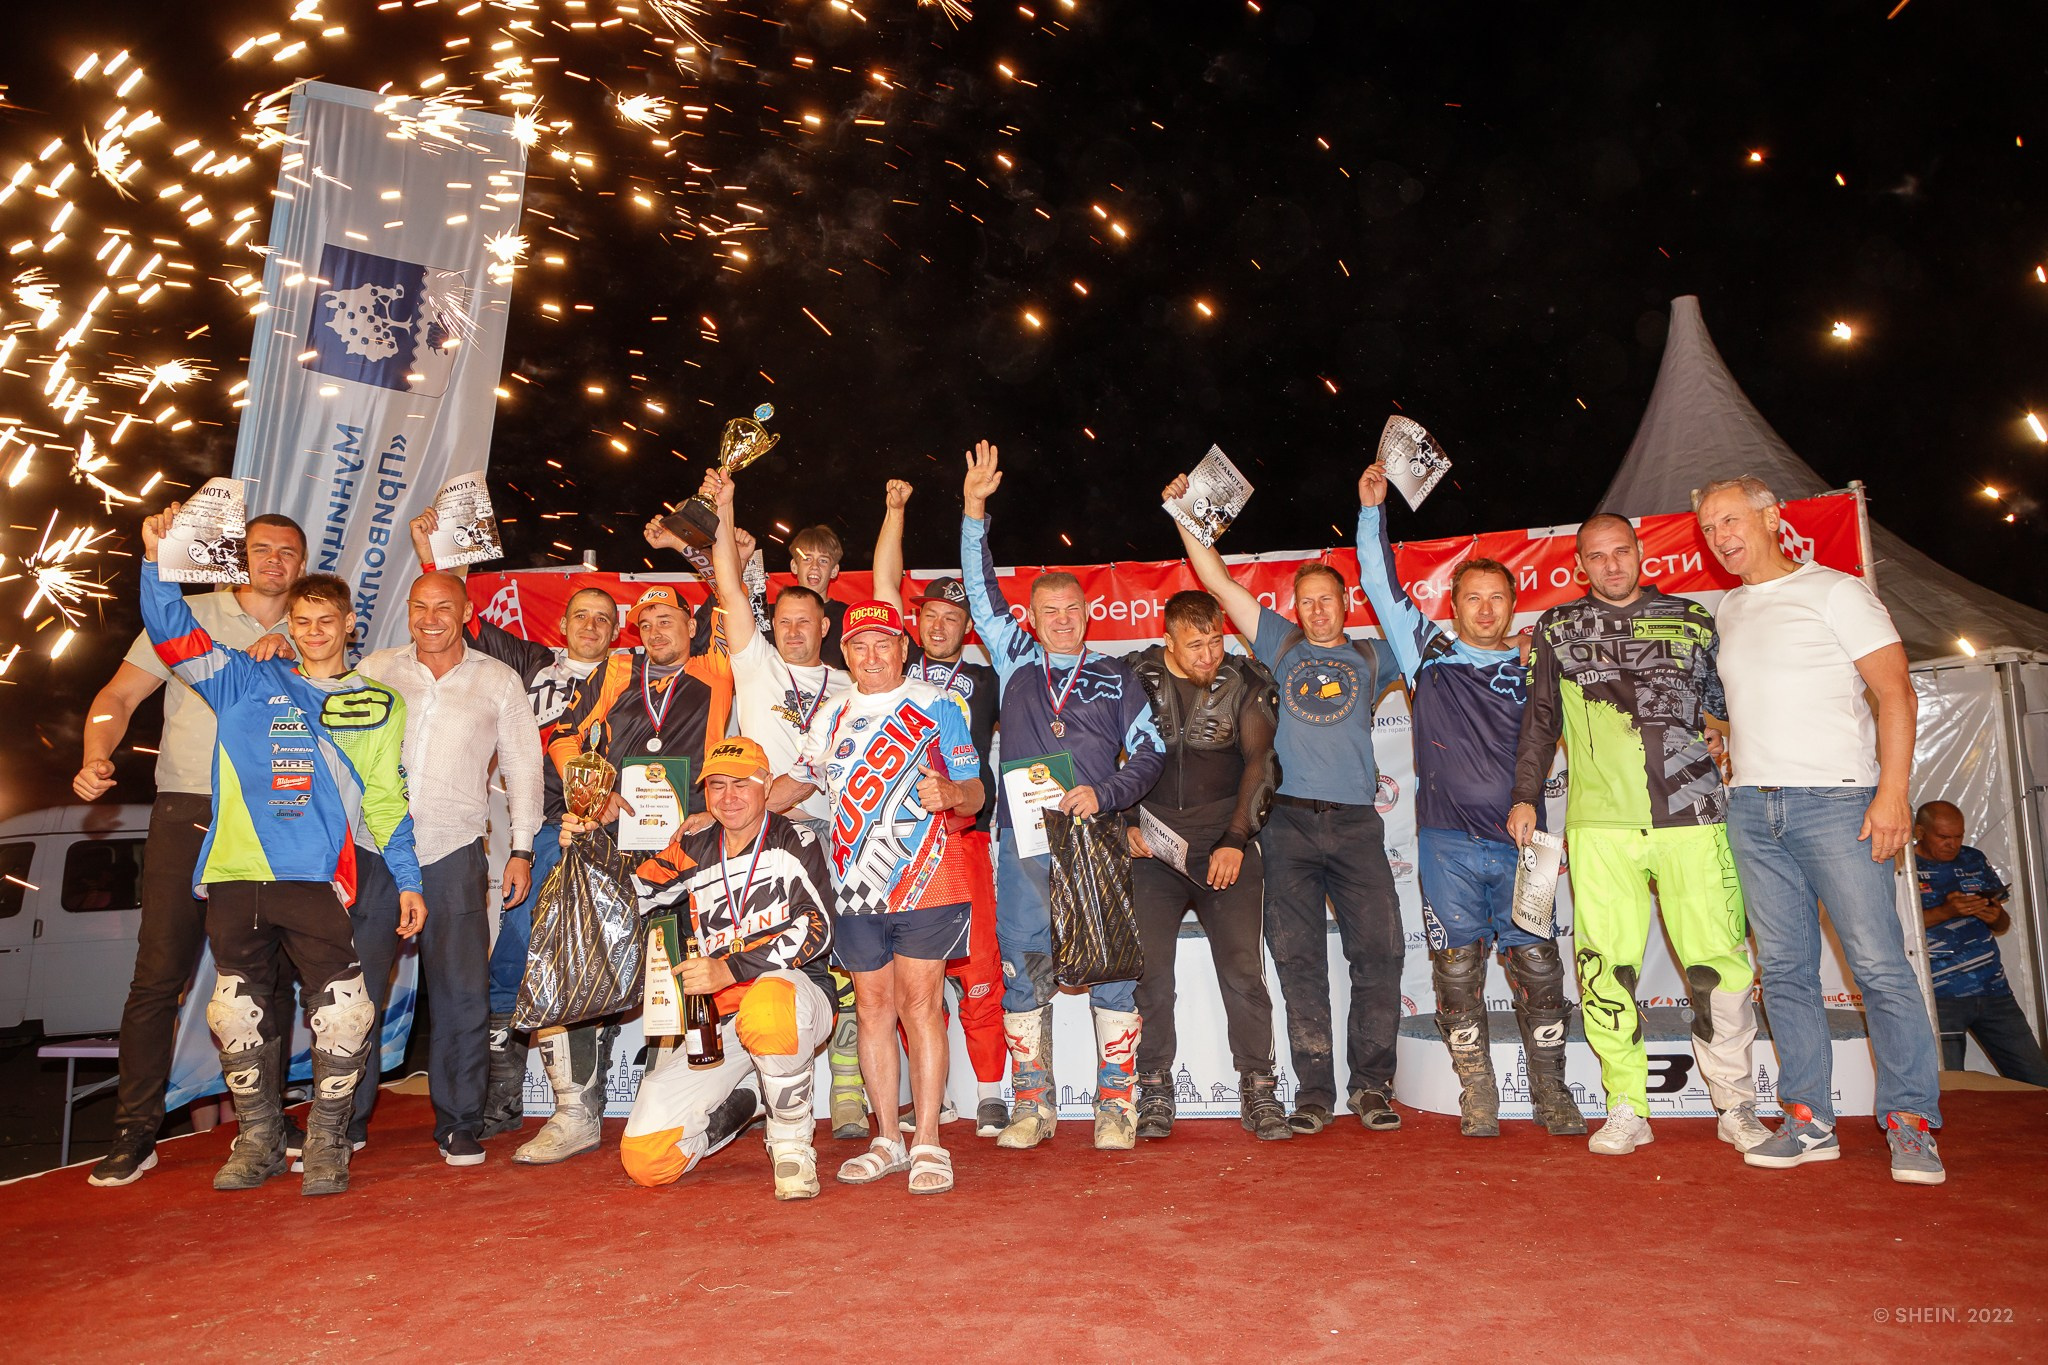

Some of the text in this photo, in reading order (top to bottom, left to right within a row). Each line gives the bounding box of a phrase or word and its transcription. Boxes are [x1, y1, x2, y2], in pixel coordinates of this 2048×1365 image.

[849, 610, 889, 626] РОССИЯ
[1569, 640, 1685, 667] ONEAL
[1327, 660, 1357, 683] BETTER
[1285, 675, 1359, 722] AROUND THE CAMPFIRE
[272, 723, 299, 731] ROCK
[782, 713, 802, 725] ENDU
[712, 744, 744, 757] KTM
[832, 703, 938, 879] RUSSIA
